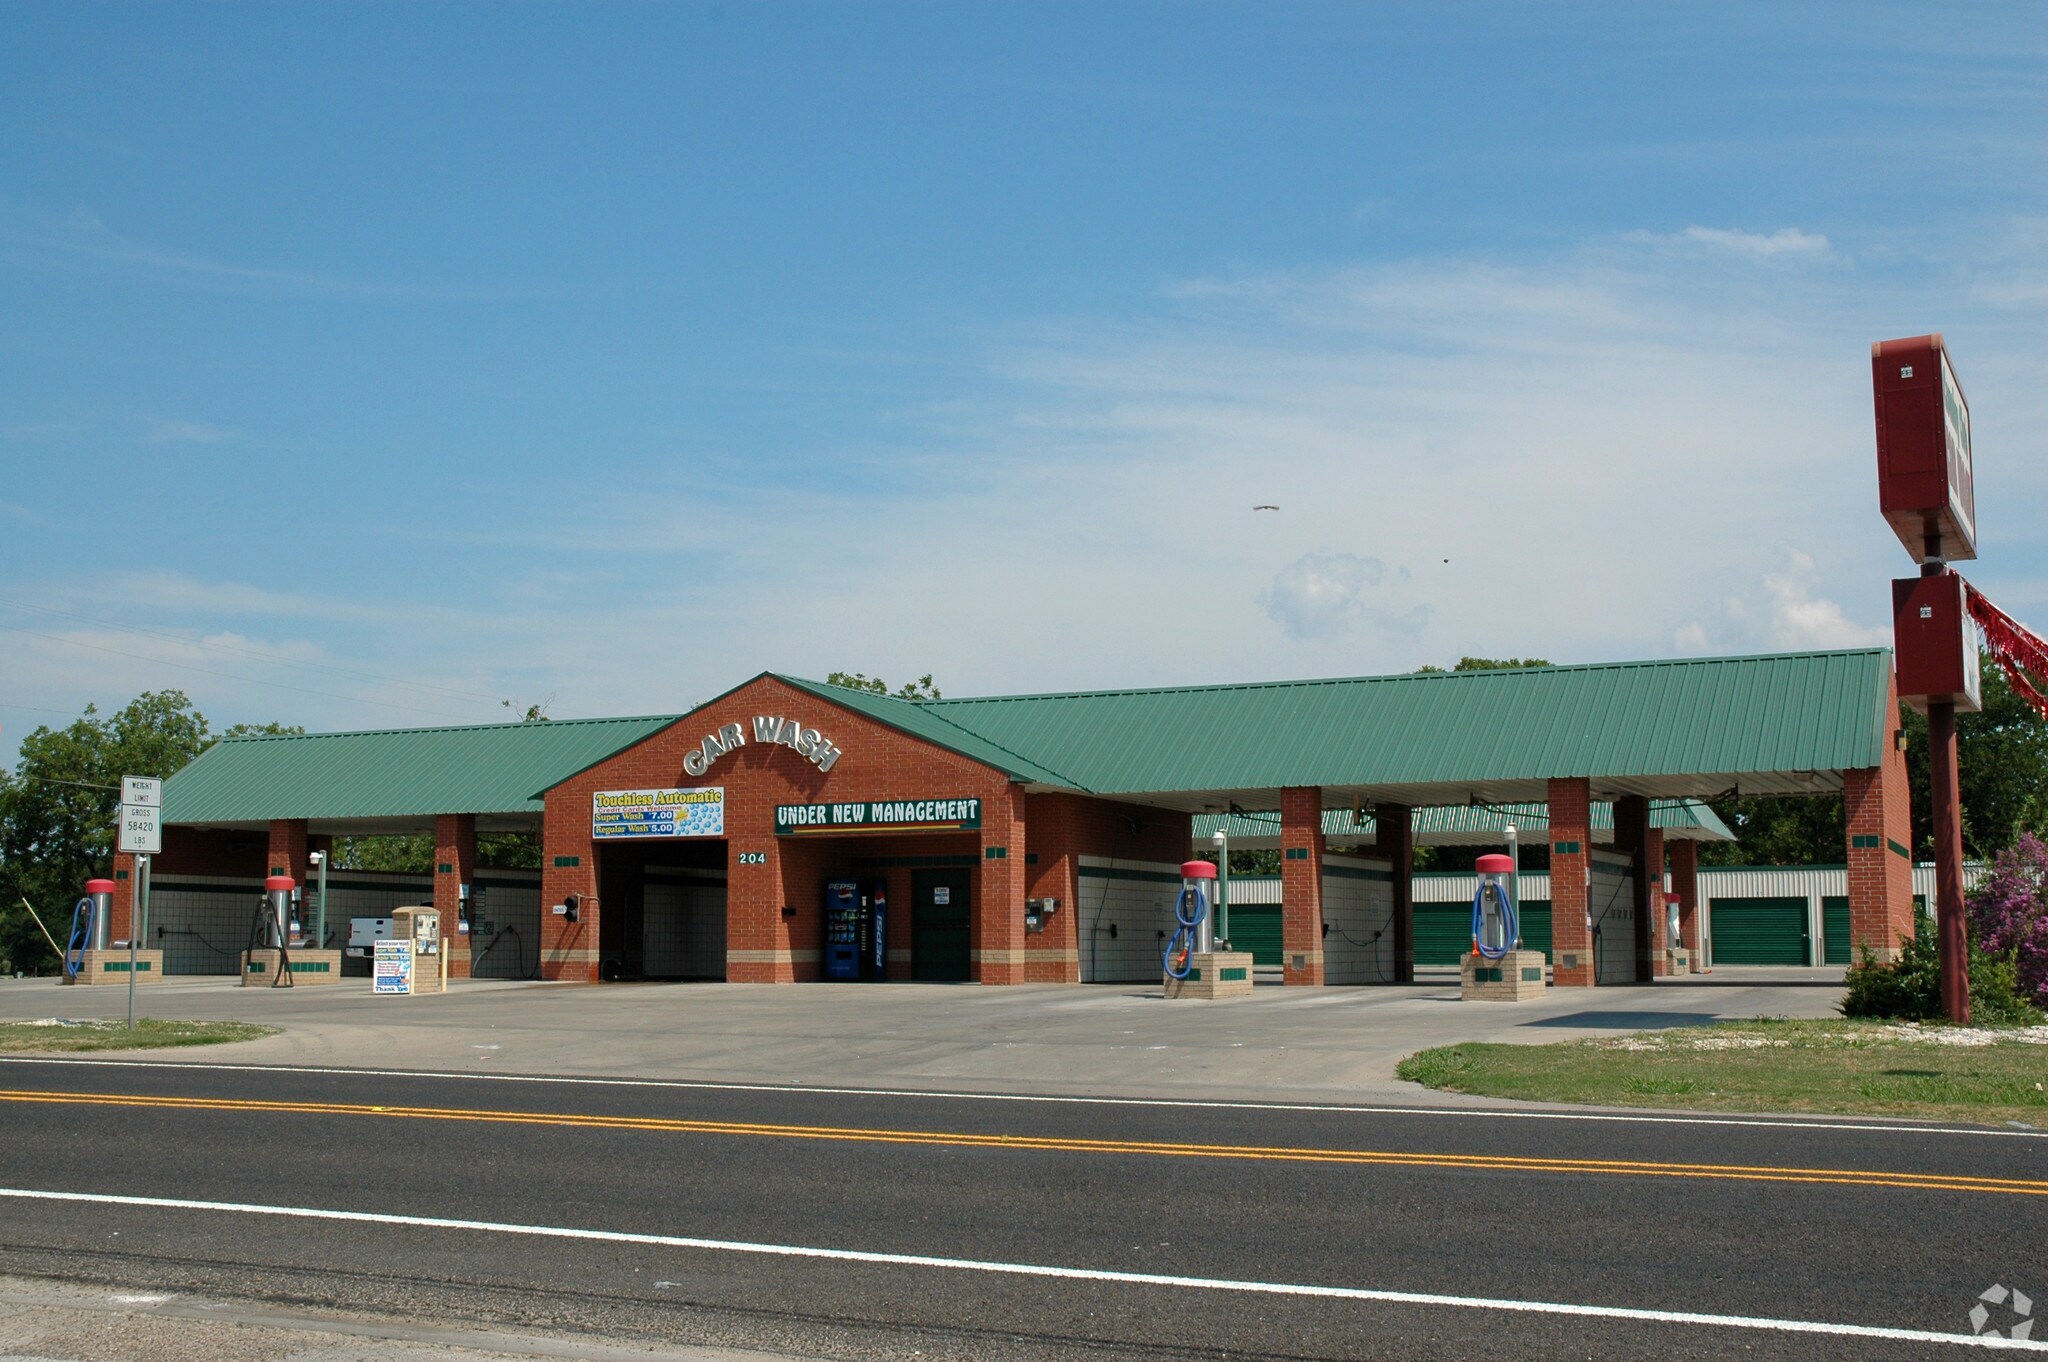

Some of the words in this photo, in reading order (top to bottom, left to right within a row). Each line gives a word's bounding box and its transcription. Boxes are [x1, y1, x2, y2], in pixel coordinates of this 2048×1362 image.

[684, 723, 746, 776] CAR
[752, 716, 842, 773] WASH
[132, 782, 152, 790] WEIGHT
[134, 794, 149, 802] LIMIT
[596, 791, 653, 807] Touchless
[655, 789, 722, 805] Automatic
[131, 808, 151, 817] GROSS
[595, 813, 620, 823] Super
[622, 812, 644, 820] Wash
[778, 806, 826, 825] UNDER
[833, 804, 865, 823] NEW
[871, 800, 978, 823] MANAGEMENT
[128, 821, 153, 832] 58420
[595, 825, 626, 834] Regular
[627, 824, 649, 833] Wash
[739, 854, 766, 864] 204
